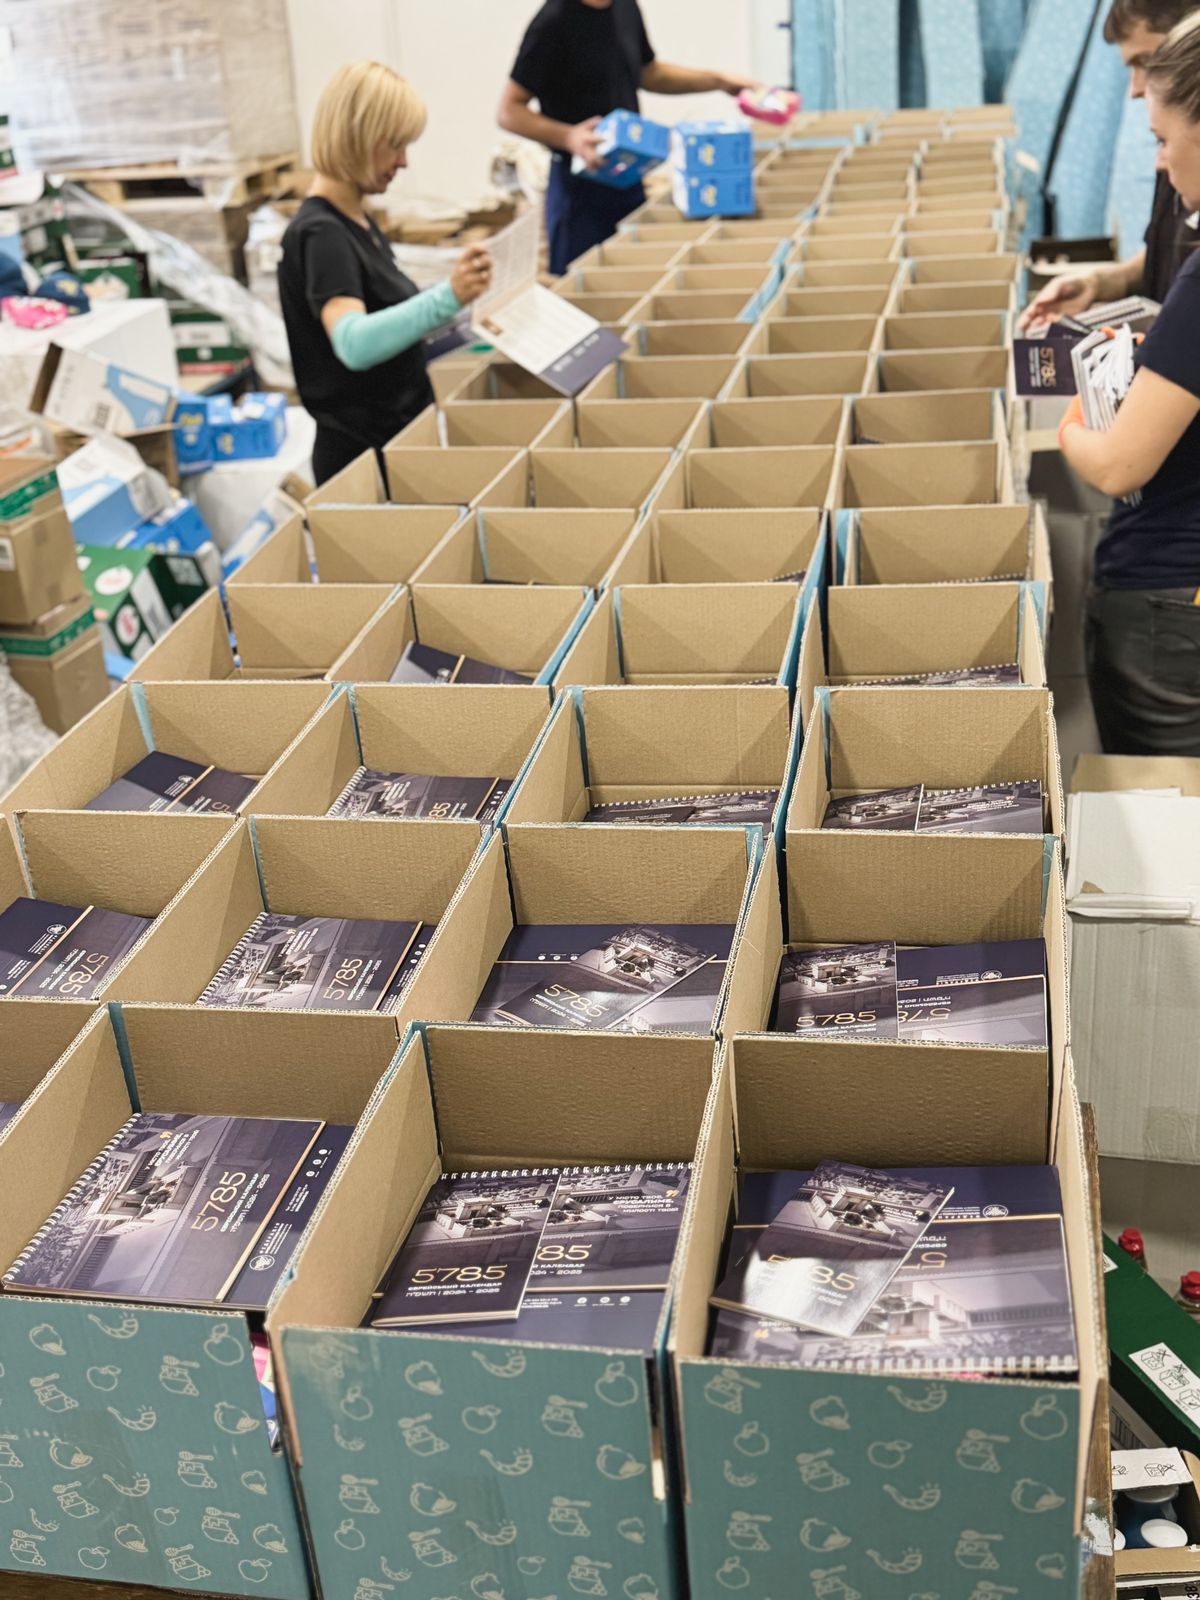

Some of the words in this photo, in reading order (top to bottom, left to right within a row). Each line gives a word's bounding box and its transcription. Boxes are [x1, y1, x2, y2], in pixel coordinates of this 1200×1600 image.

[428, 802, 451, 818] 85
[59, 952, 110, 994] 5785
[323, 958, 363, 1001] 5785
[544, 983, 610, 1018] 5785
[796, 1010, 877, 1028] 5785
[191, 1171, 248, 1232] 5785
[536, 1244, 592, 1261] 85
[411, 1264, 508, 1284] 5785
